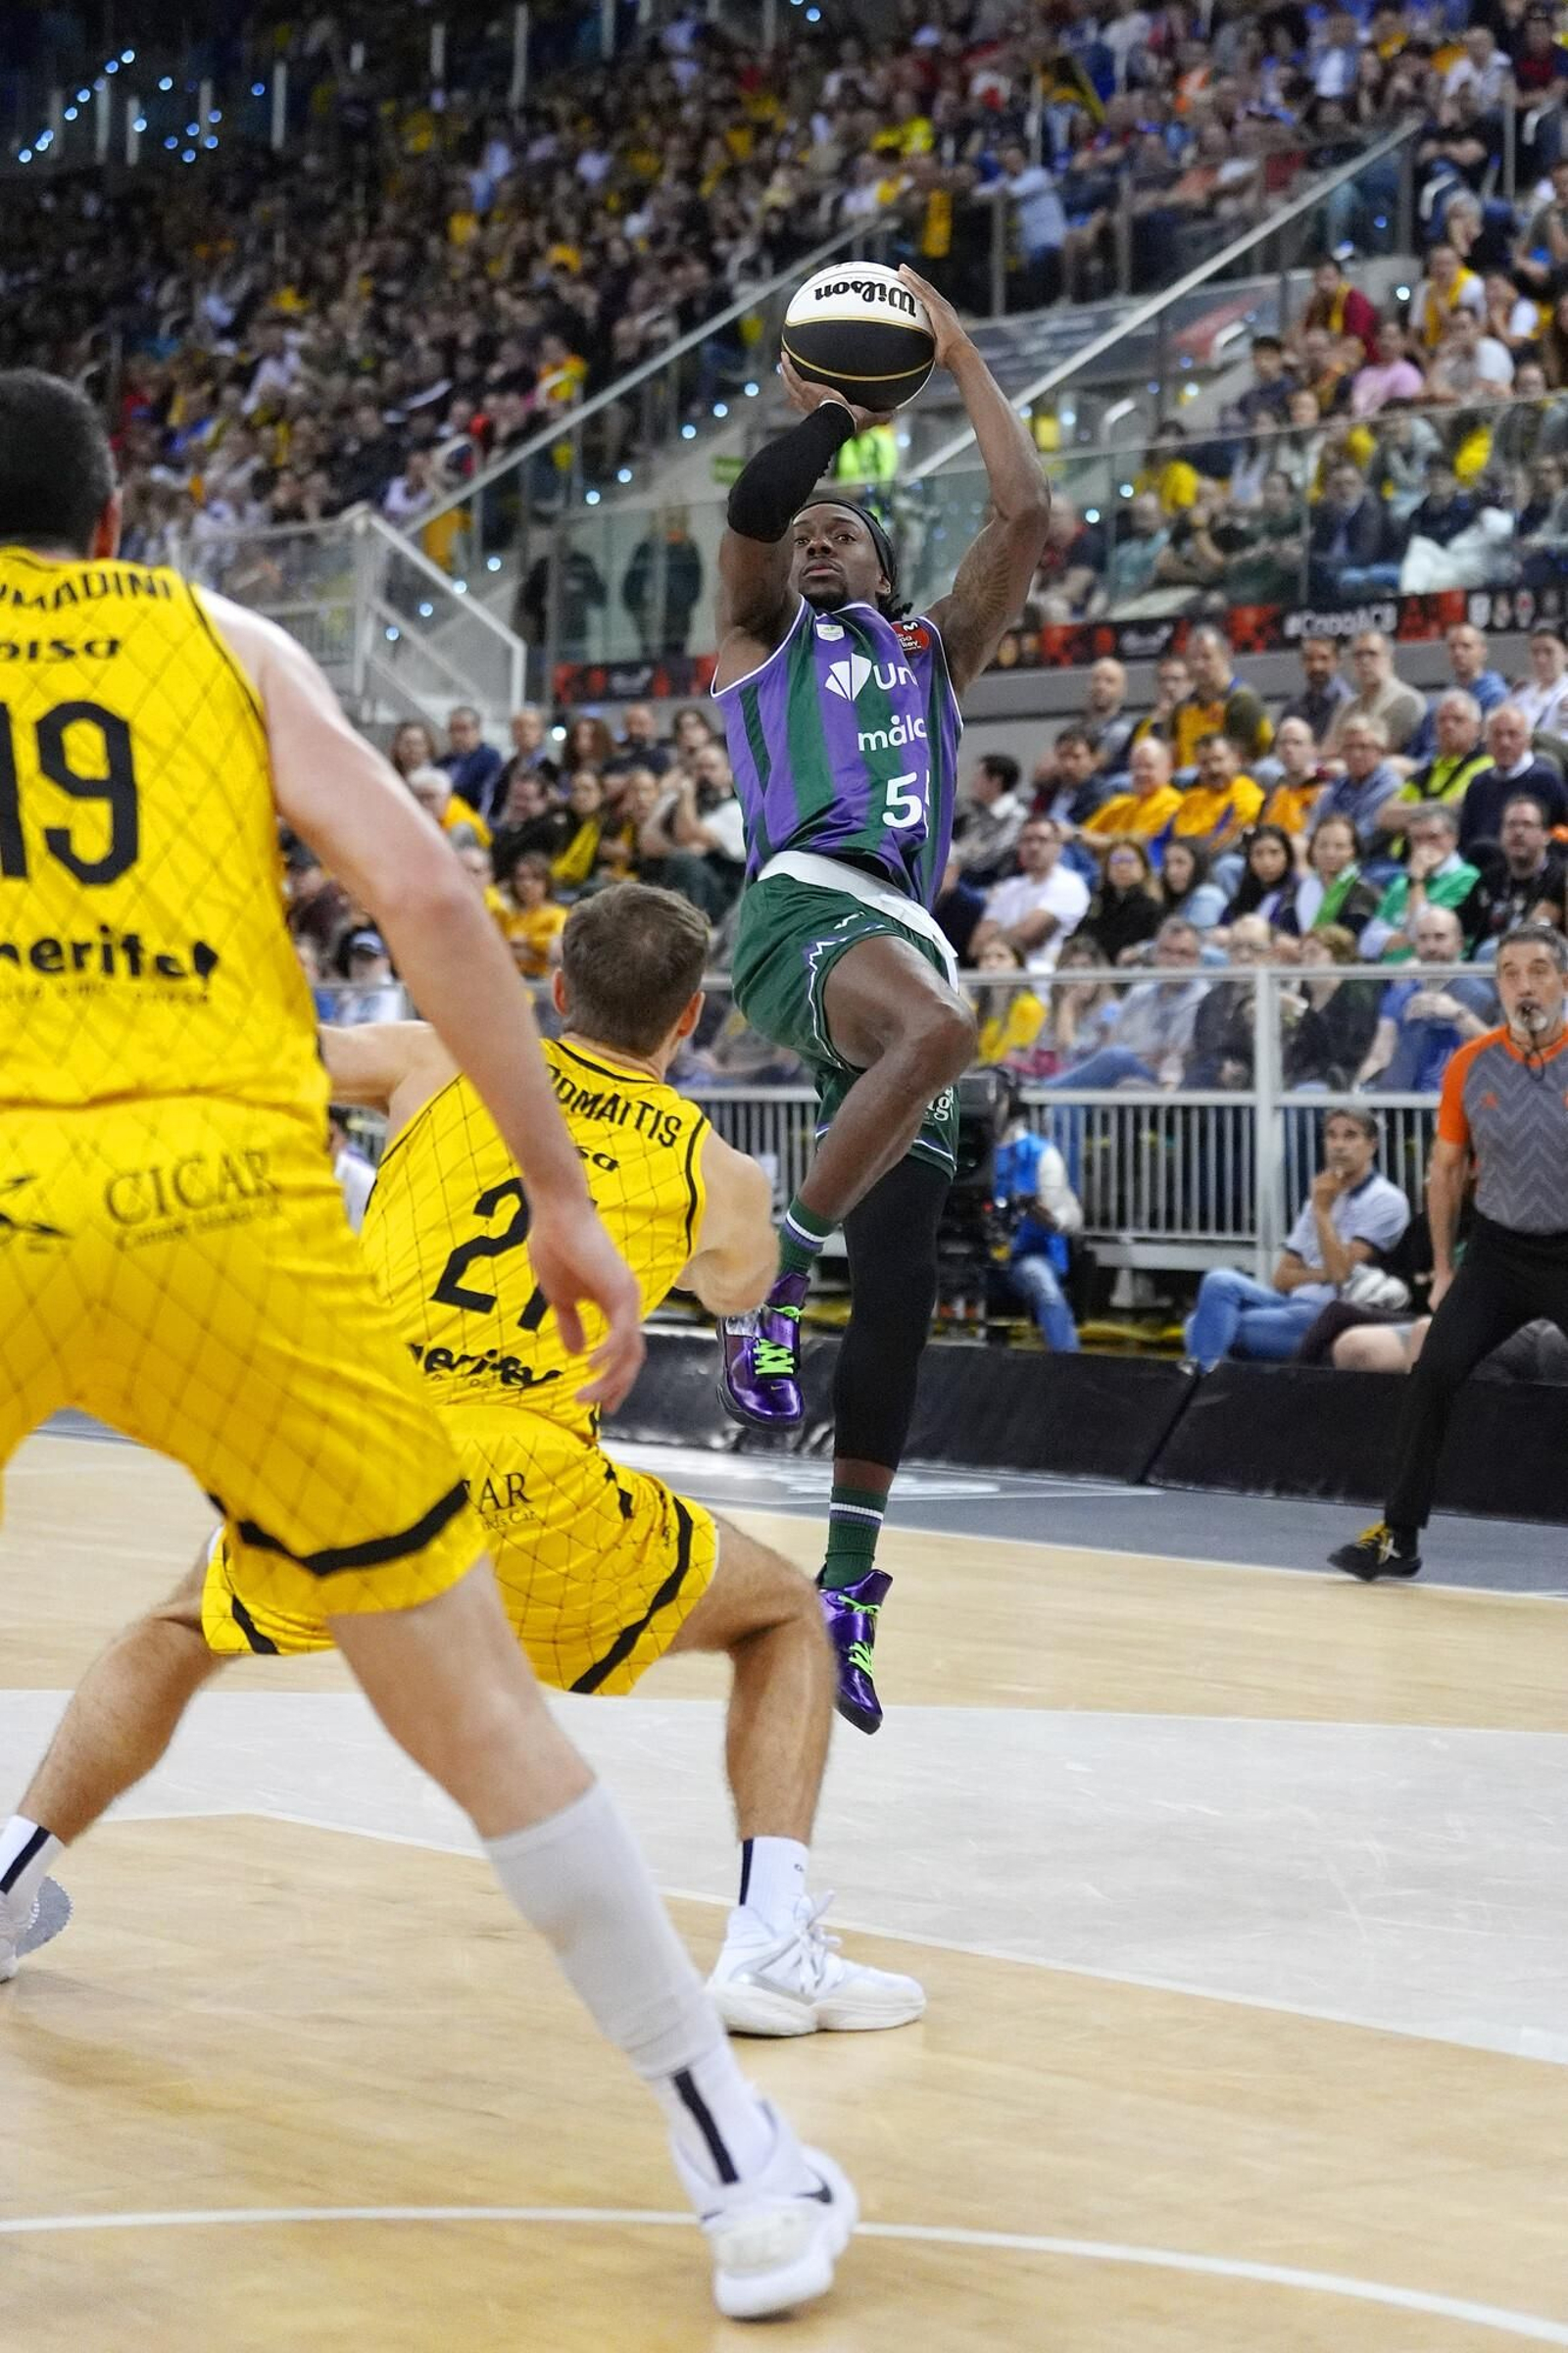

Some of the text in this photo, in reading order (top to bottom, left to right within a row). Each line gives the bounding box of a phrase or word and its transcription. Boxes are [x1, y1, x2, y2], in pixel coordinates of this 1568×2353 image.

[814, 281, 916, 318] Wilson
[0, 571, 171, 610] MADINI
[0, 701, 138, 887] 19
[882, 769, 930, 838] 5
[105, 1149, 282, 1225] CICAR
[466, 1472, 534, 1514] AR
